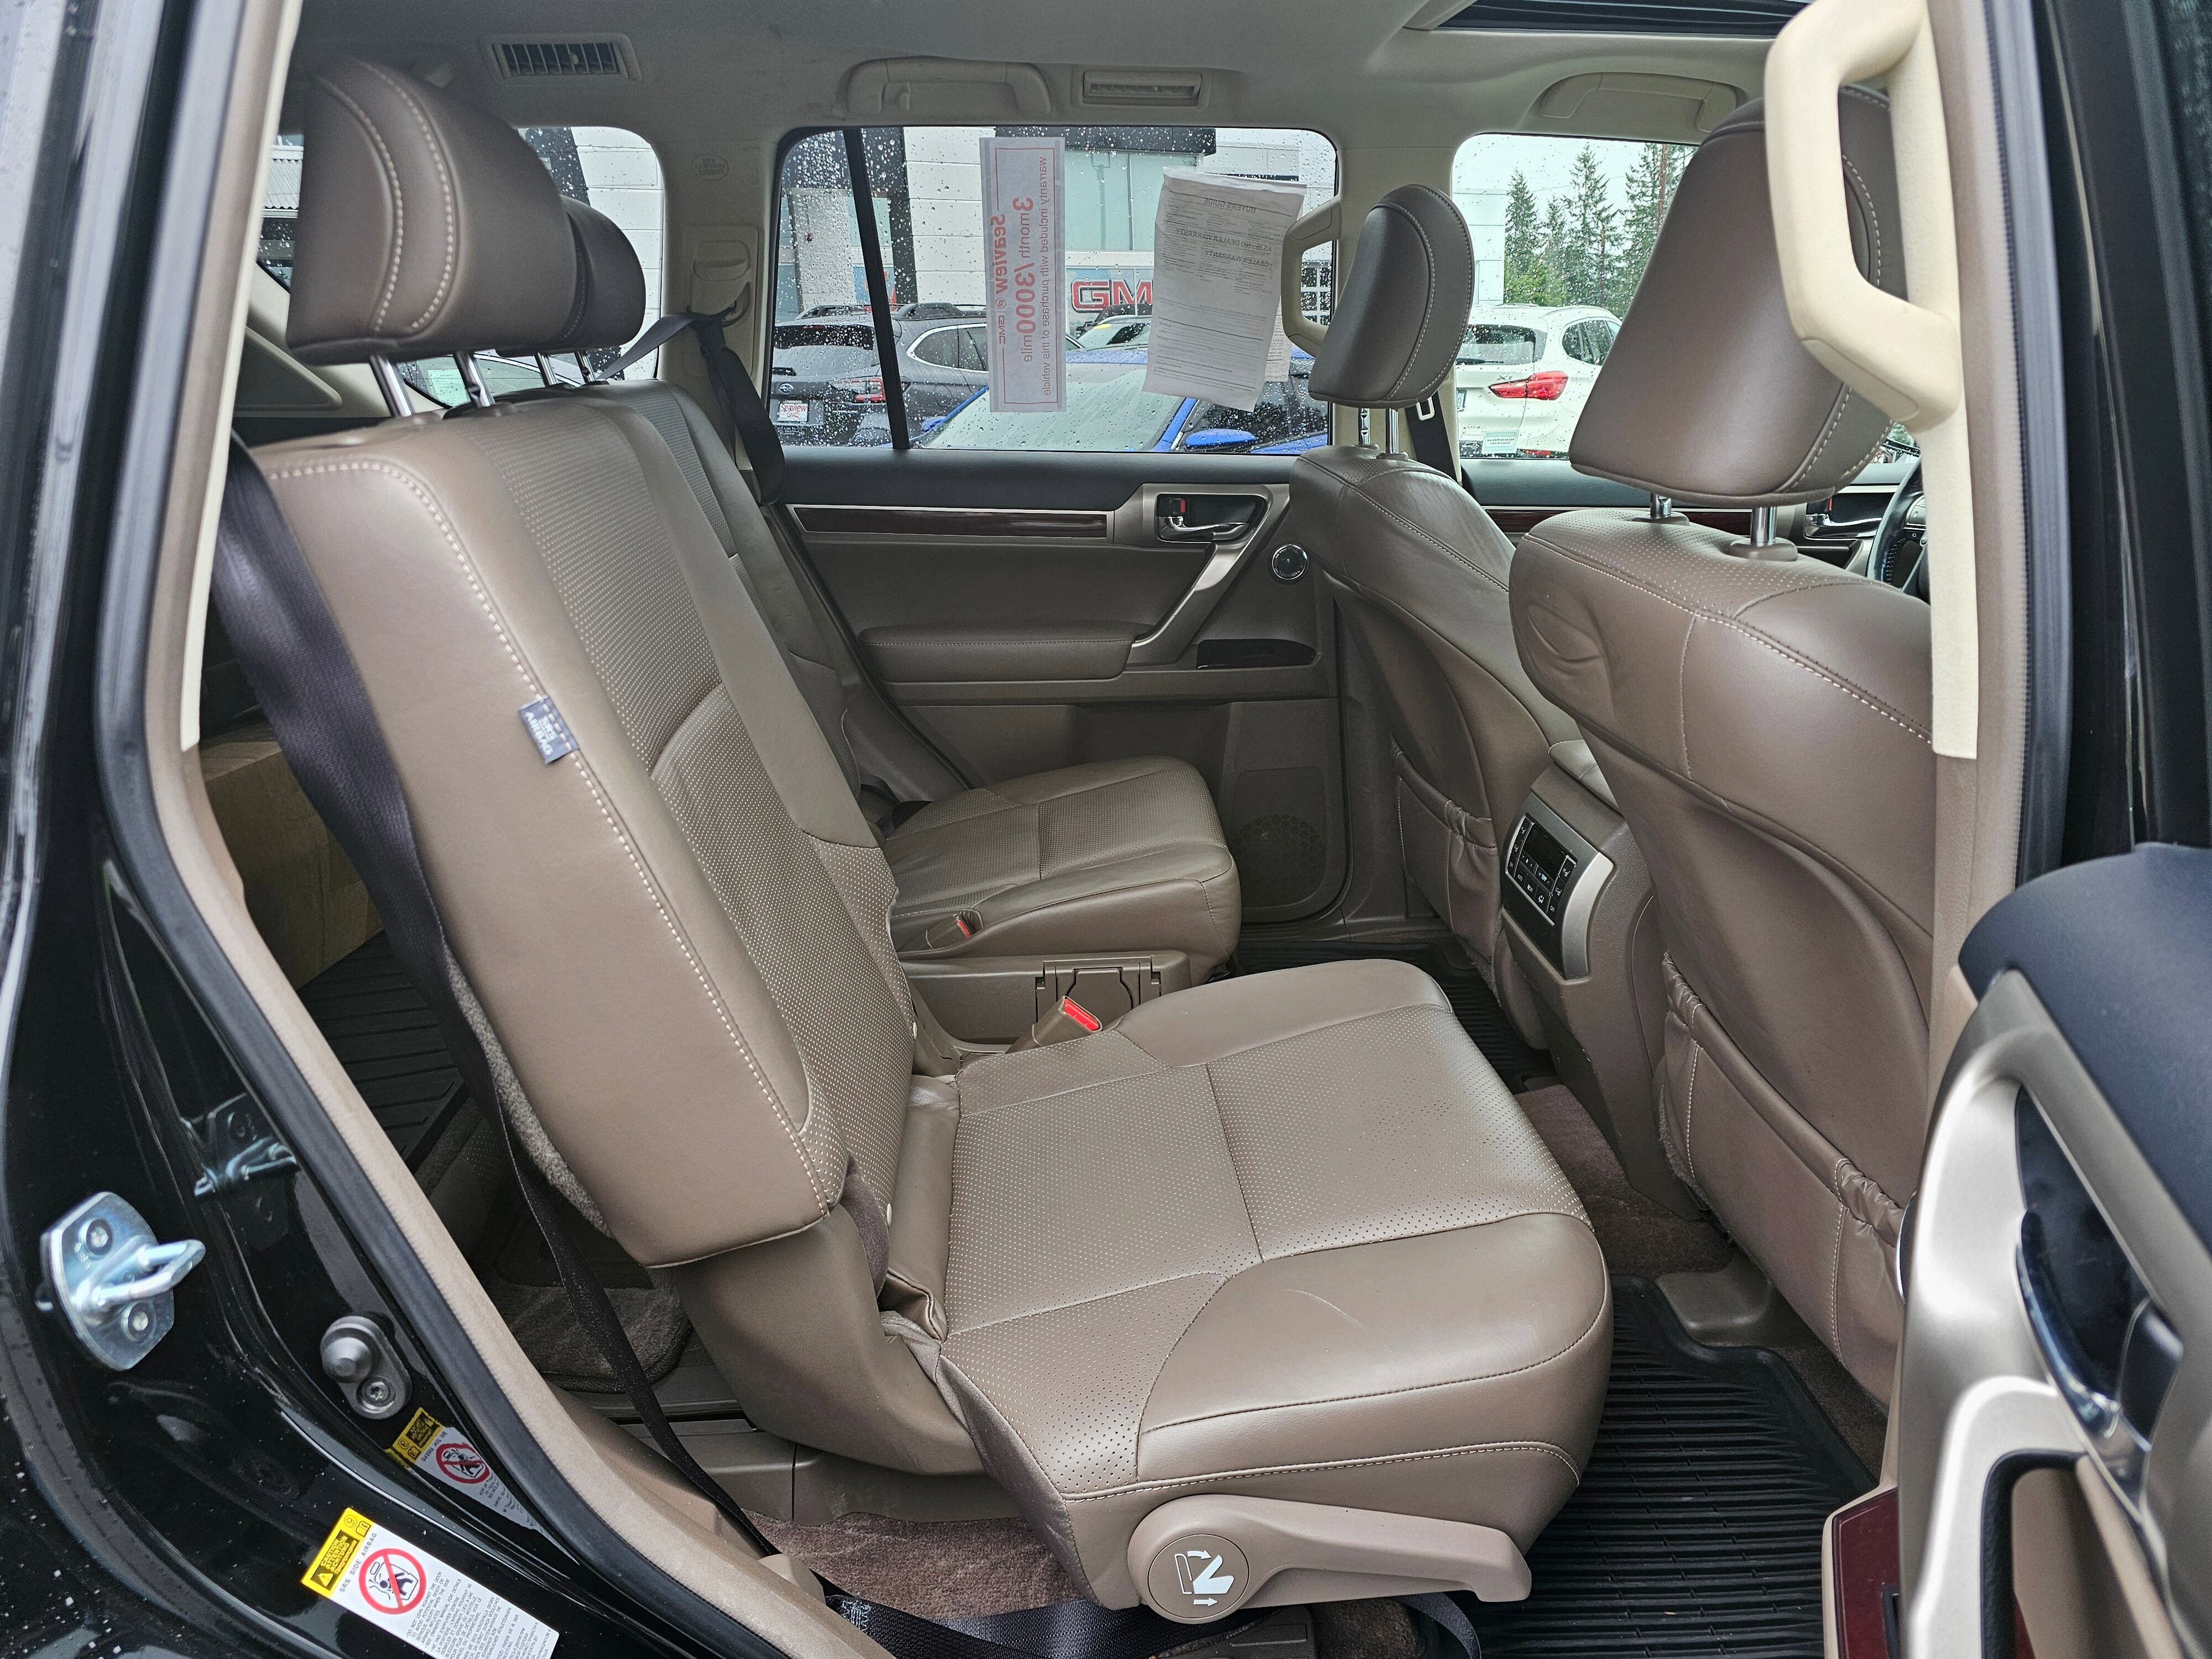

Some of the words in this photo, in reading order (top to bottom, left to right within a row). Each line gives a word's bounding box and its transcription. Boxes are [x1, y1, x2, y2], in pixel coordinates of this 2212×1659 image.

[781, 404, 807, 413] Seaview
[525, 712, 553, 755] AIRBAG
[345, 1516, 356, 1526] 9
[320, 1538, 340, 1567] CAUTION
[325, 1535, 348, 1569] ATTENTION
[329, 1542, 350, 1572] ACHTUNG
[339, 1577, 351, 1593] SRS
[349, 1558, 362, 1575] SIDE
[360, 1532, 377, 1556] AIRBAG
[421, 1590, 432, 1607] AGAINST
[421, 1597, 434, 1618] POTENTIAL
[432, 1584, 441, 1597] DEATH
[432, 1596, 441, 1608] WHEN
